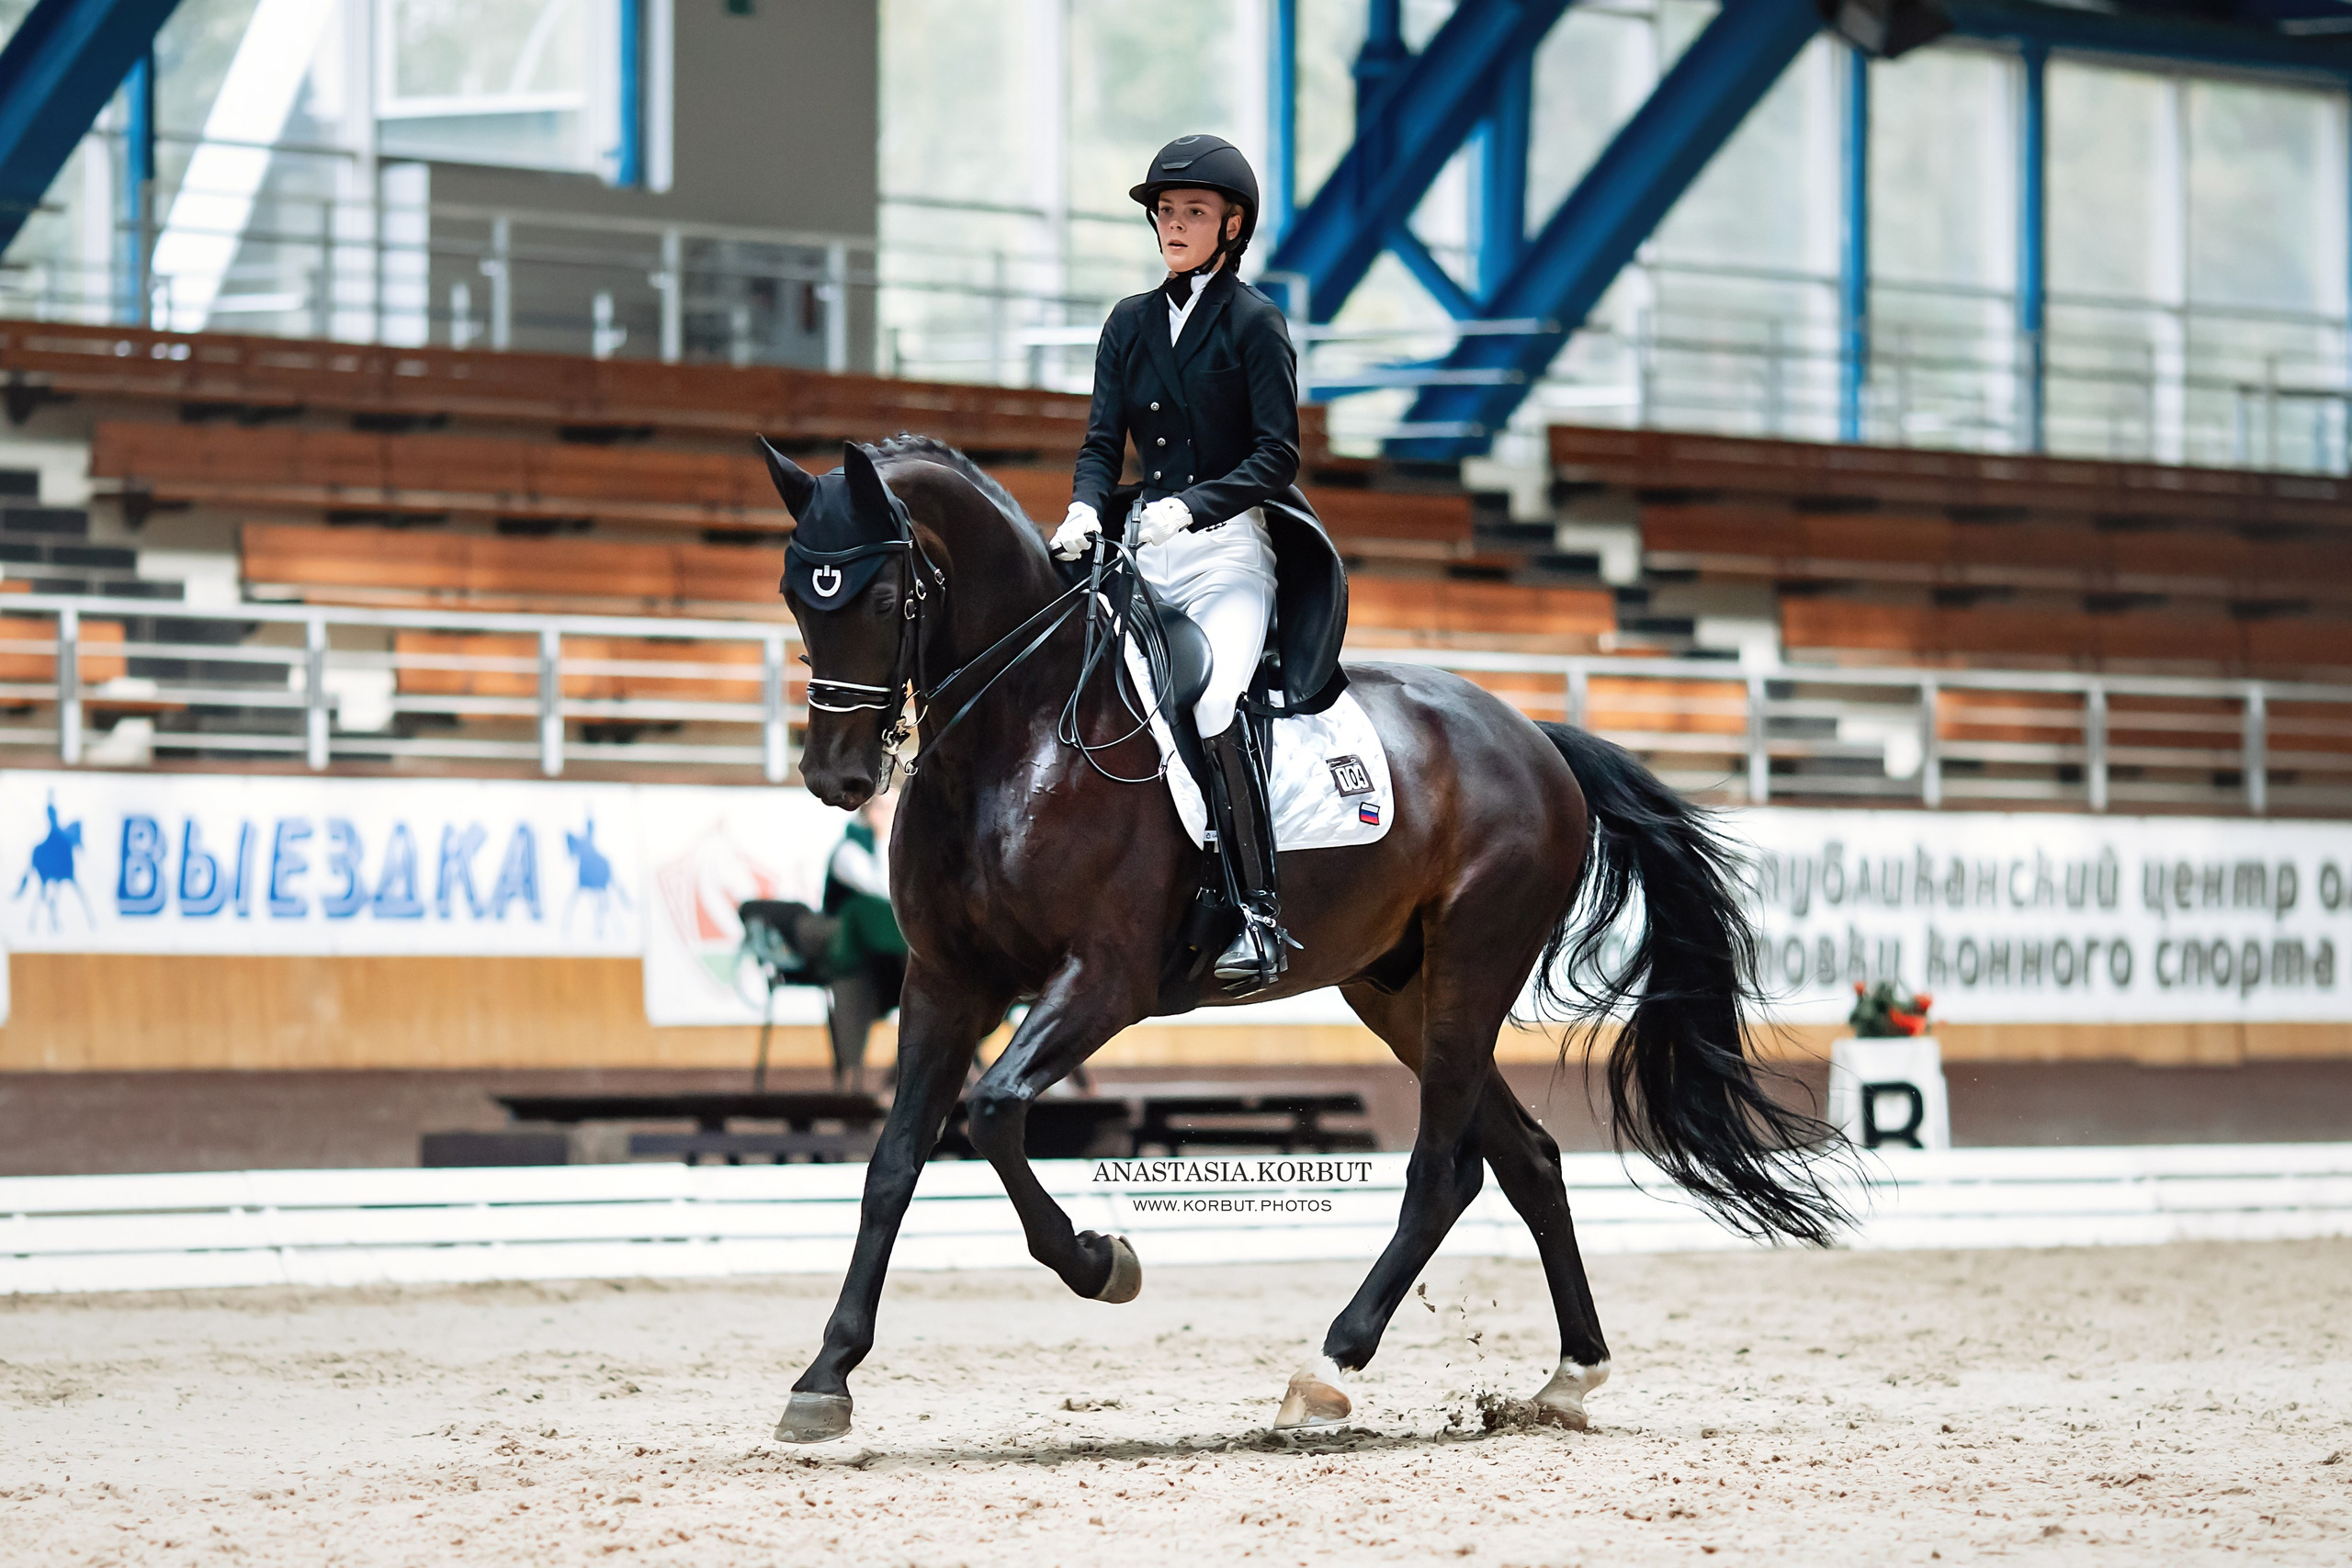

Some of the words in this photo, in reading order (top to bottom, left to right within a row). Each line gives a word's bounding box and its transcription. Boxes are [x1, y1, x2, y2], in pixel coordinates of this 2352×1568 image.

[1339, 767, 1366, 788] 104
[117, 814, 544, 919] ВЫЕЗДКА
[1758, 840, 2119, 918] публиканский
[2143, 859, 2299, 921] центр
[2318, 859, 2352, 913] о
[1926, 921, 2133, 988] конного
[2154, 935, 2335, 999] спорта
[1861, 1081, 1925, 1149] R
